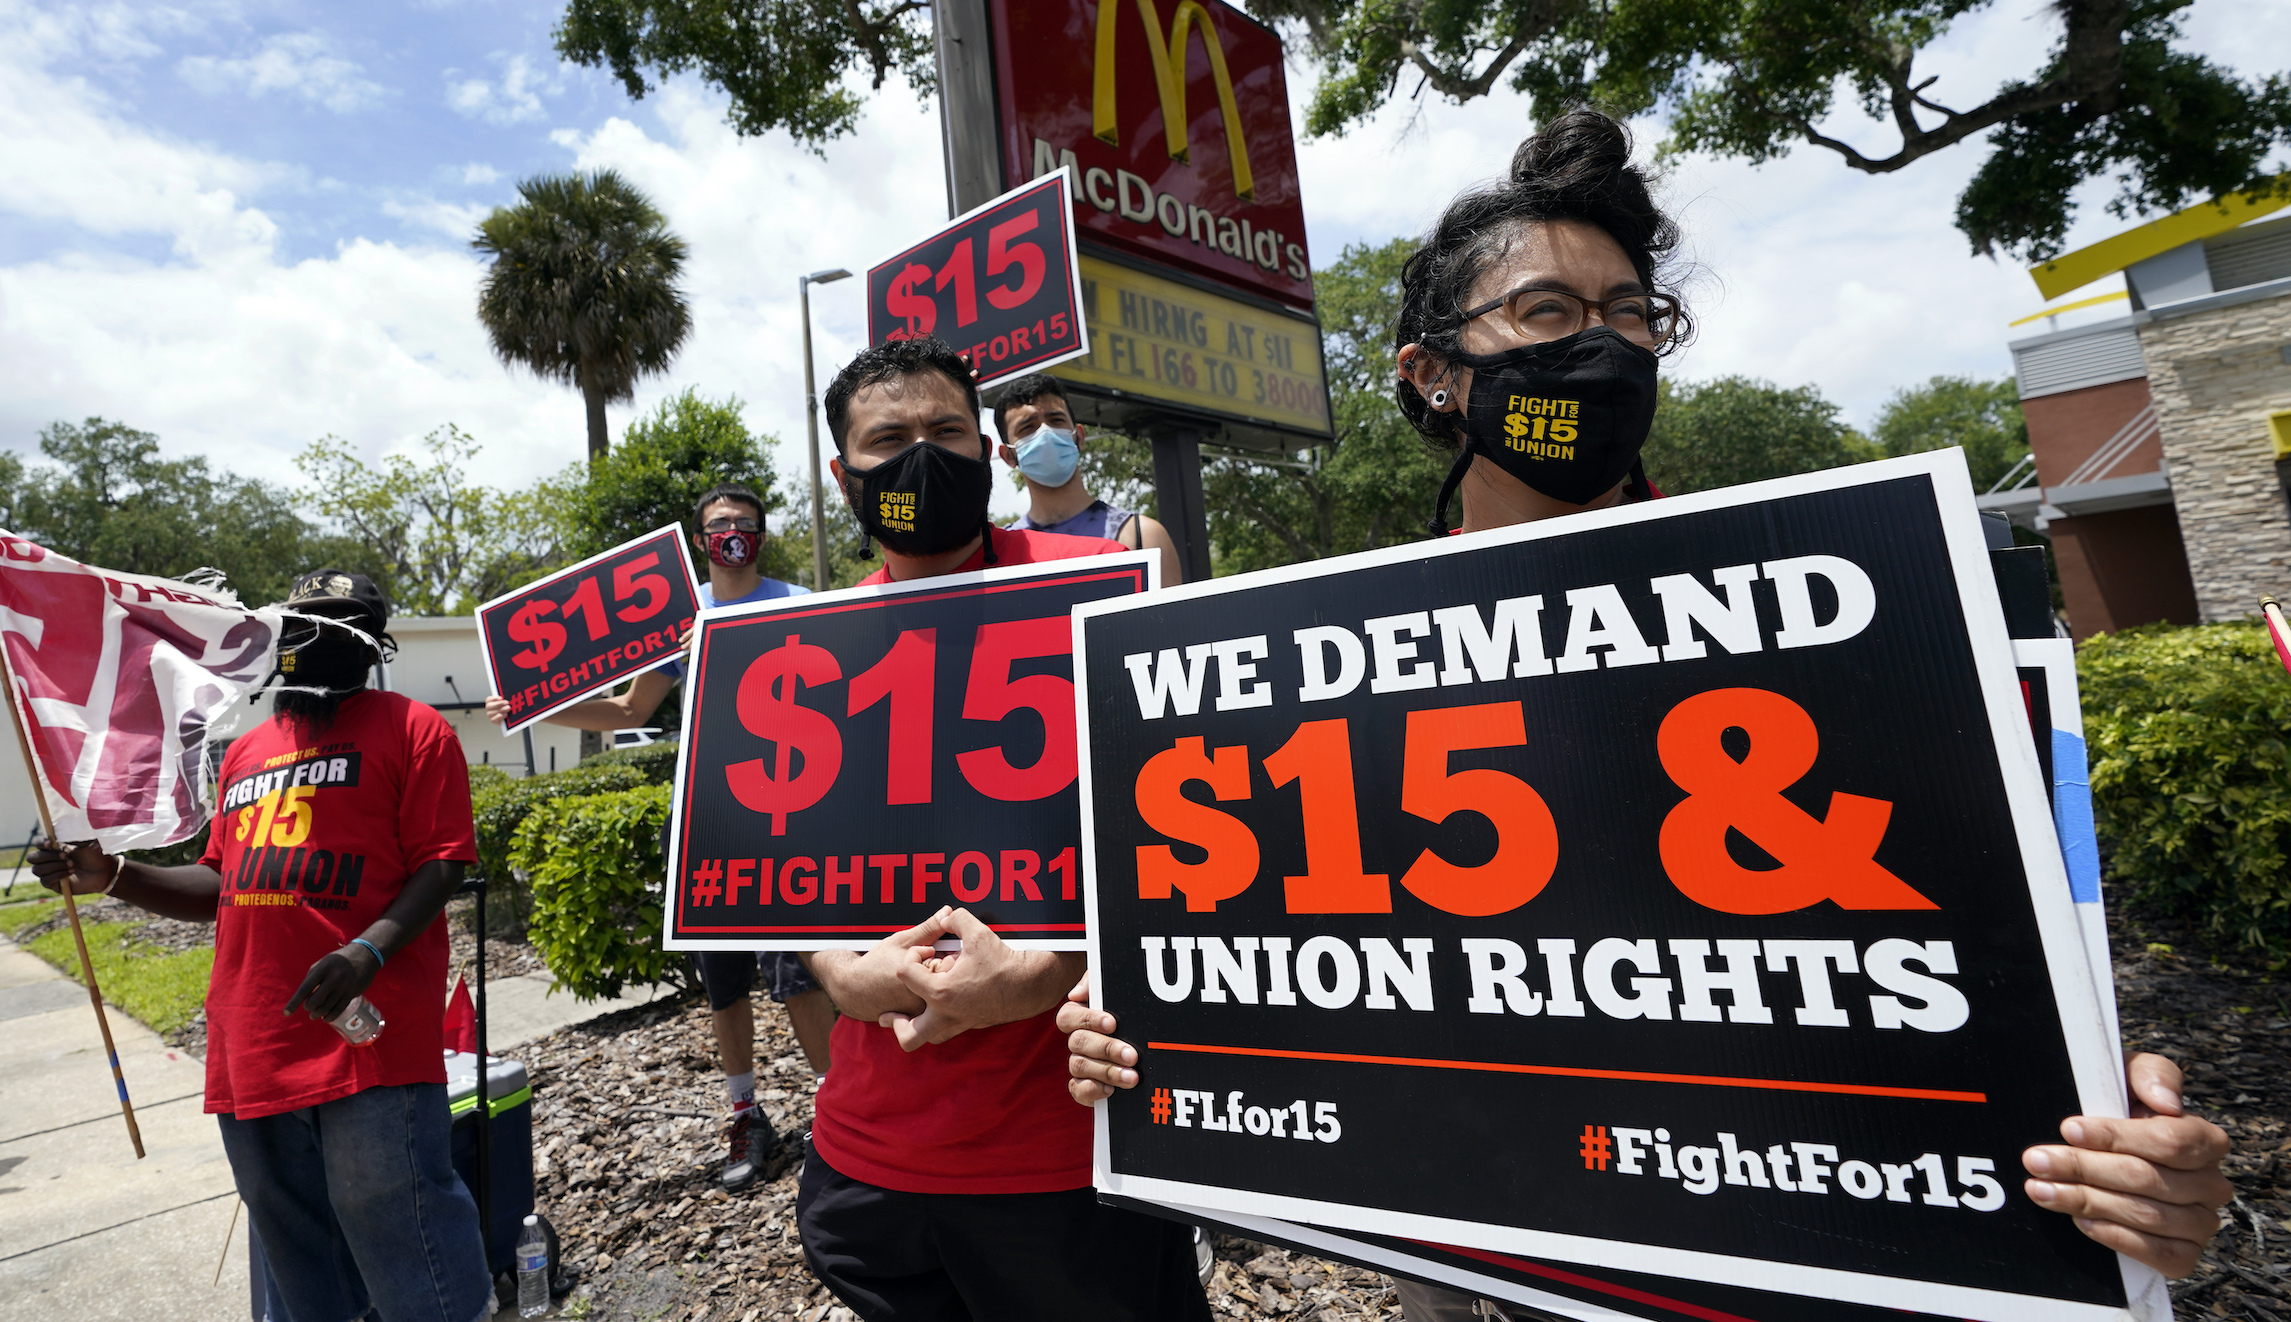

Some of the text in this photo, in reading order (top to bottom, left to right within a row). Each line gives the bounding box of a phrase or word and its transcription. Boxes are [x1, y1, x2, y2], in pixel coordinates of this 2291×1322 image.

[1033, 138, 1307, 281] McDonald's
[886, 209, 1046, 342] $15
[1118, 289, 1208, 348] HIRNG
[1227, 321, 1255, 360] AT
[1109, 331, 1145, 378] FL
[1203, 357, 1238, 398] TO
[1503, 412, 1579, 443] $15
[1508, 395, 1580, 417] FIGHT
[1513, 438, 1575, 461] UNION
[879, 502, 915, 521] $15
[880, 491, 915, 504] FIGHT
[885, 519, 914, 533] UNION
[507, 551, 671, 674] $15
[1125, 554, 1876, 720] WE DEMAND
[508, 616, 694, 716] #FIGHTFOR15
[725, 615, 1079, 837] $15
[223, 757, 349, 813] FIGHT FOR
[264, 750, 304, 769] PROTECT
[235, 785, 317, 849] $15
[1136, 688, 1941, 917] $15 &
[236, 846, 365, 897] UNION
[692, 846, 1076, 907] #FIGHTFOR1
[1141, 936, 1970, 1033] UNION RIGHTS
[1151, 1088, 1342, 1143] #FLfor15
[1580, 1125, 2006, 1212] #FightFor15
